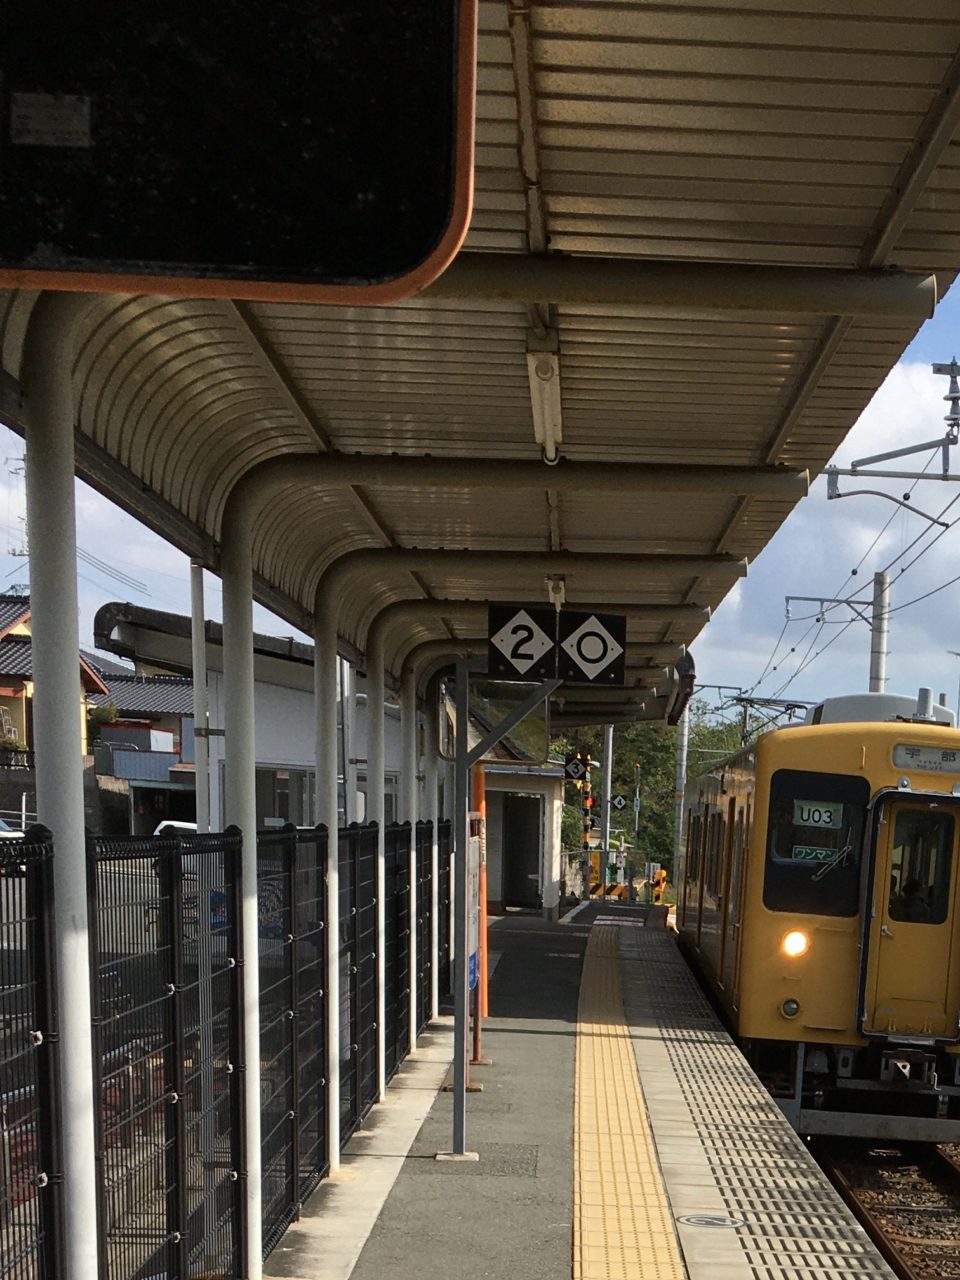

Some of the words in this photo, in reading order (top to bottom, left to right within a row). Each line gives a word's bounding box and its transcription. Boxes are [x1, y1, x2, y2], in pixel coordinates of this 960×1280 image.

[510, 624, 534, 661] 2
[800, 806, 833, 824] U03
[795, 848, 837, 861] ワンマン
